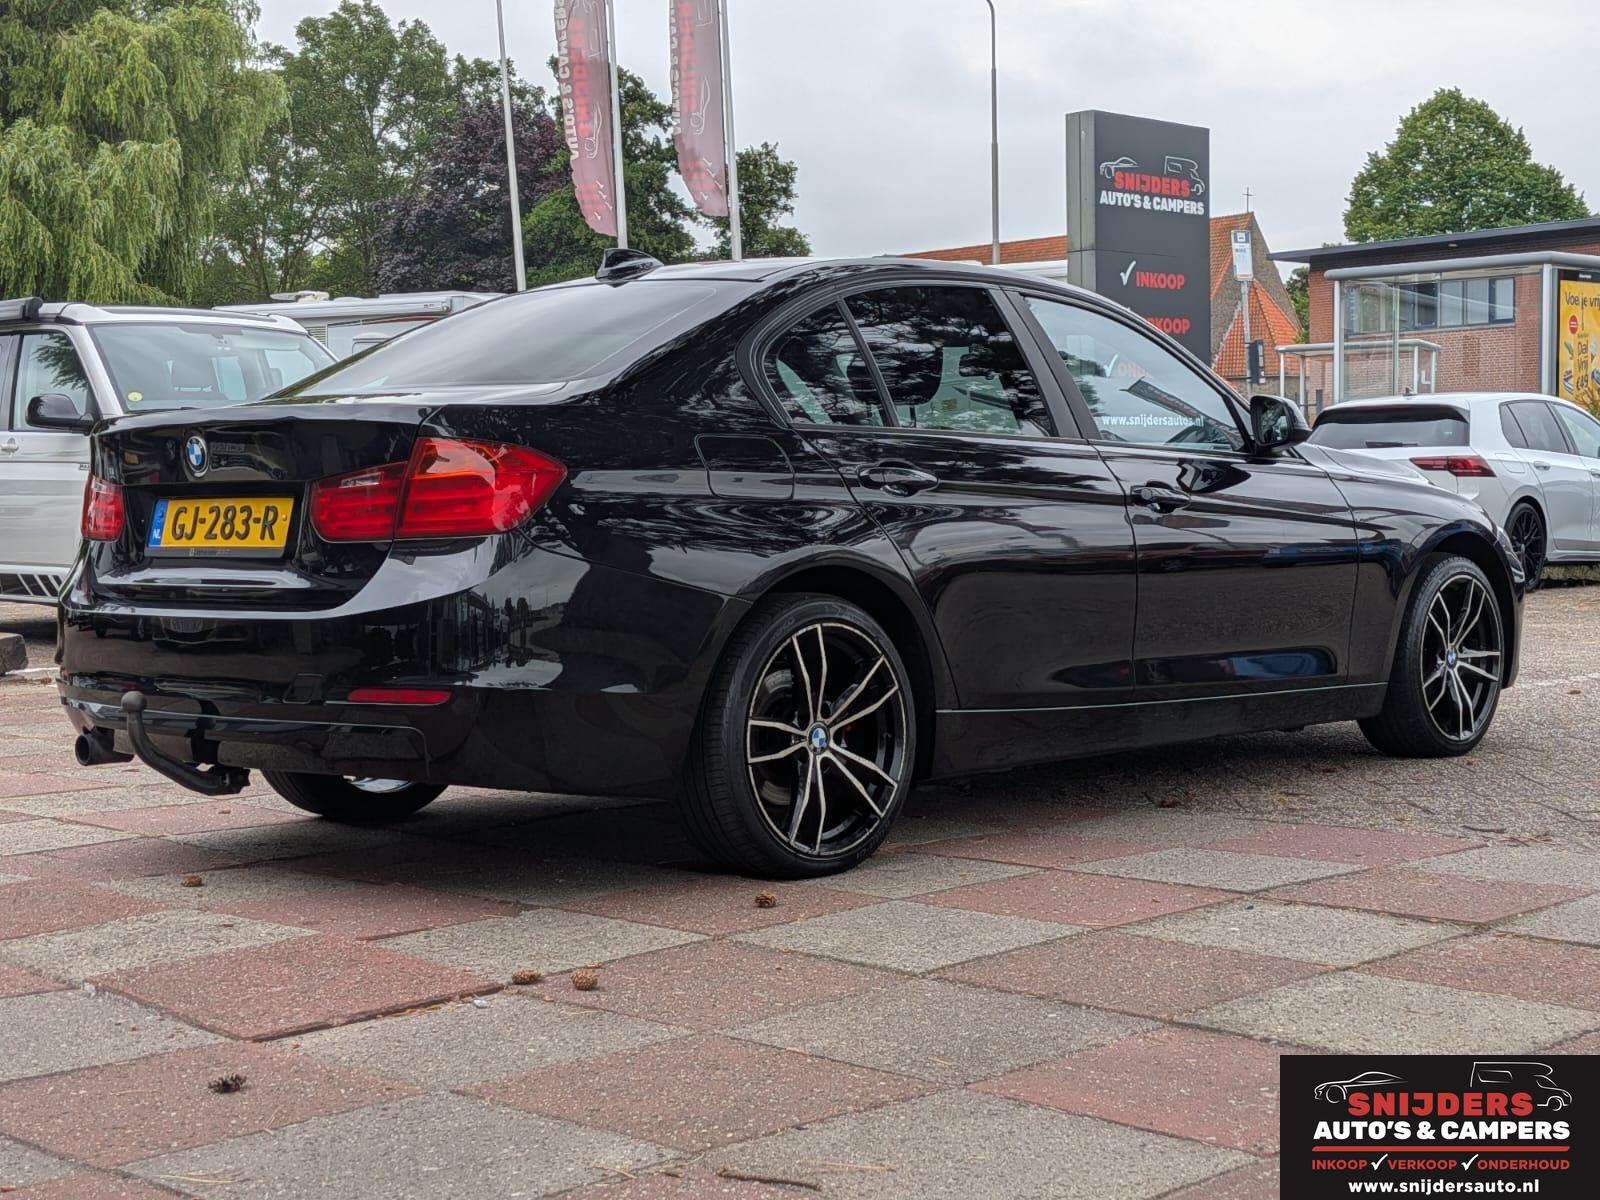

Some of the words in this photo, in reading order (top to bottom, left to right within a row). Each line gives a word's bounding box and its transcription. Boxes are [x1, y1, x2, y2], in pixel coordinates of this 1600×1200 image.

[1114, 171, 1191, 198] SNIJDERS
[1100, 190, 1142, 209] AUTO'S
[1143, 195, 1152, 209] &
[1153, 196, 1205, 215] CAMPERS
[1136, 271, 1185, 290] INKOOP
[152, 528, 162, 540] NL
[171, 505, 279, 541] GJ-283-R
